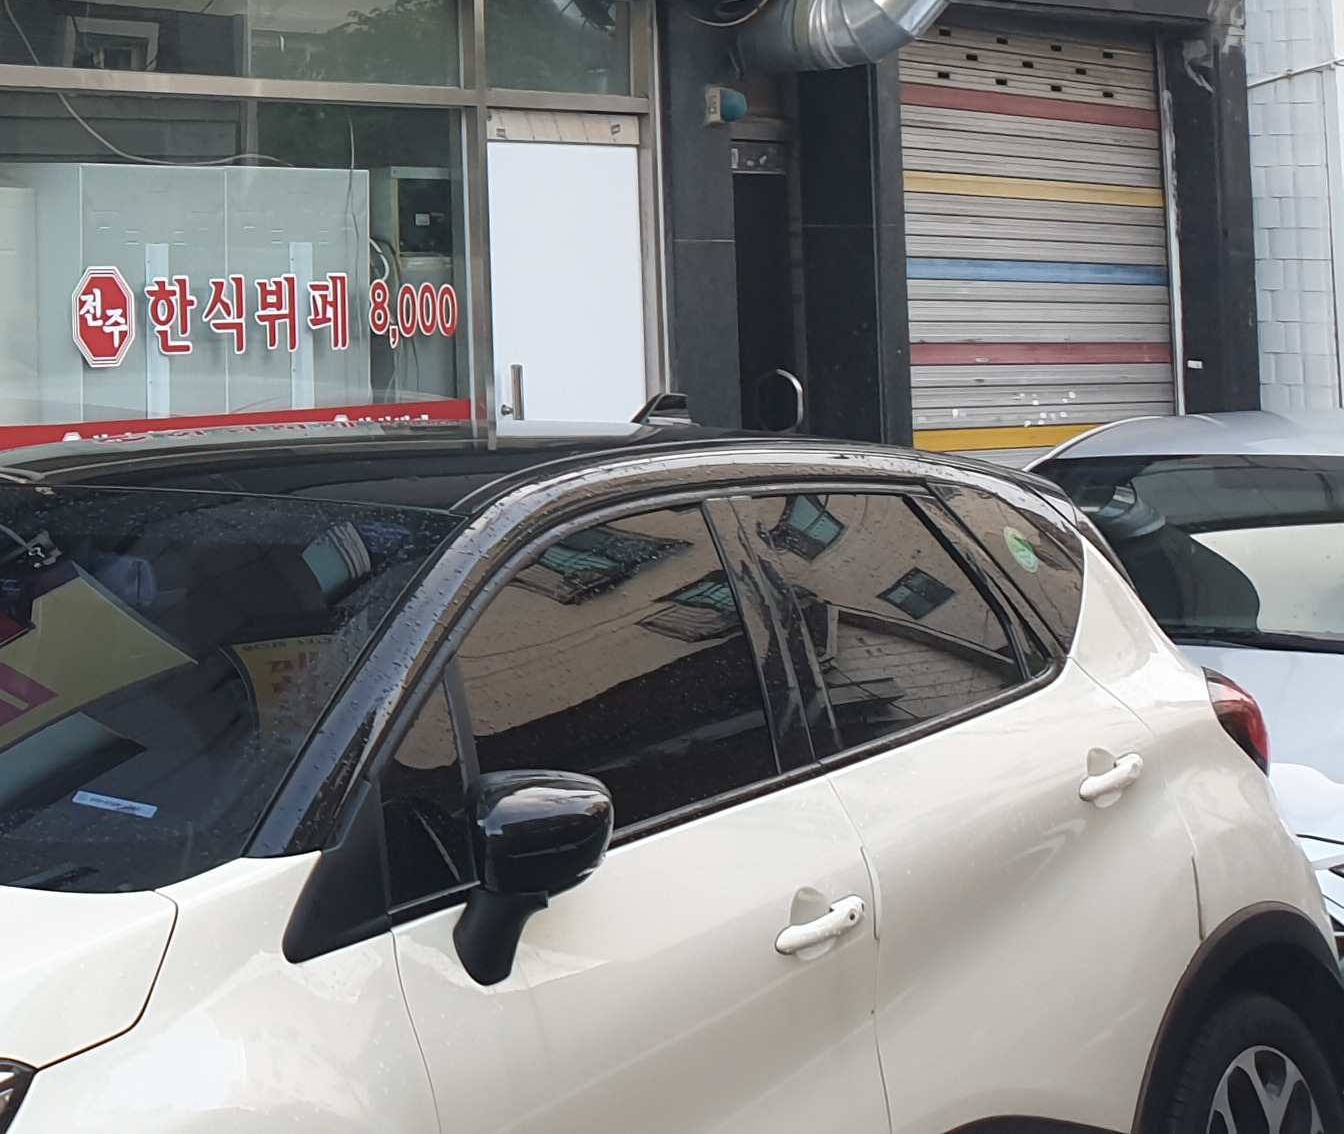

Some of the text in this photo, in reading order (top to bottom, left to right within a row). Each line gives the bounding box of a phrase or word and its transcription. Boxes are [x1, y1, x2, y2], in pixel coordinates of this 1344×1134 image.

[77, 272, 458, 355] 전주 한식뷔페 8,000
